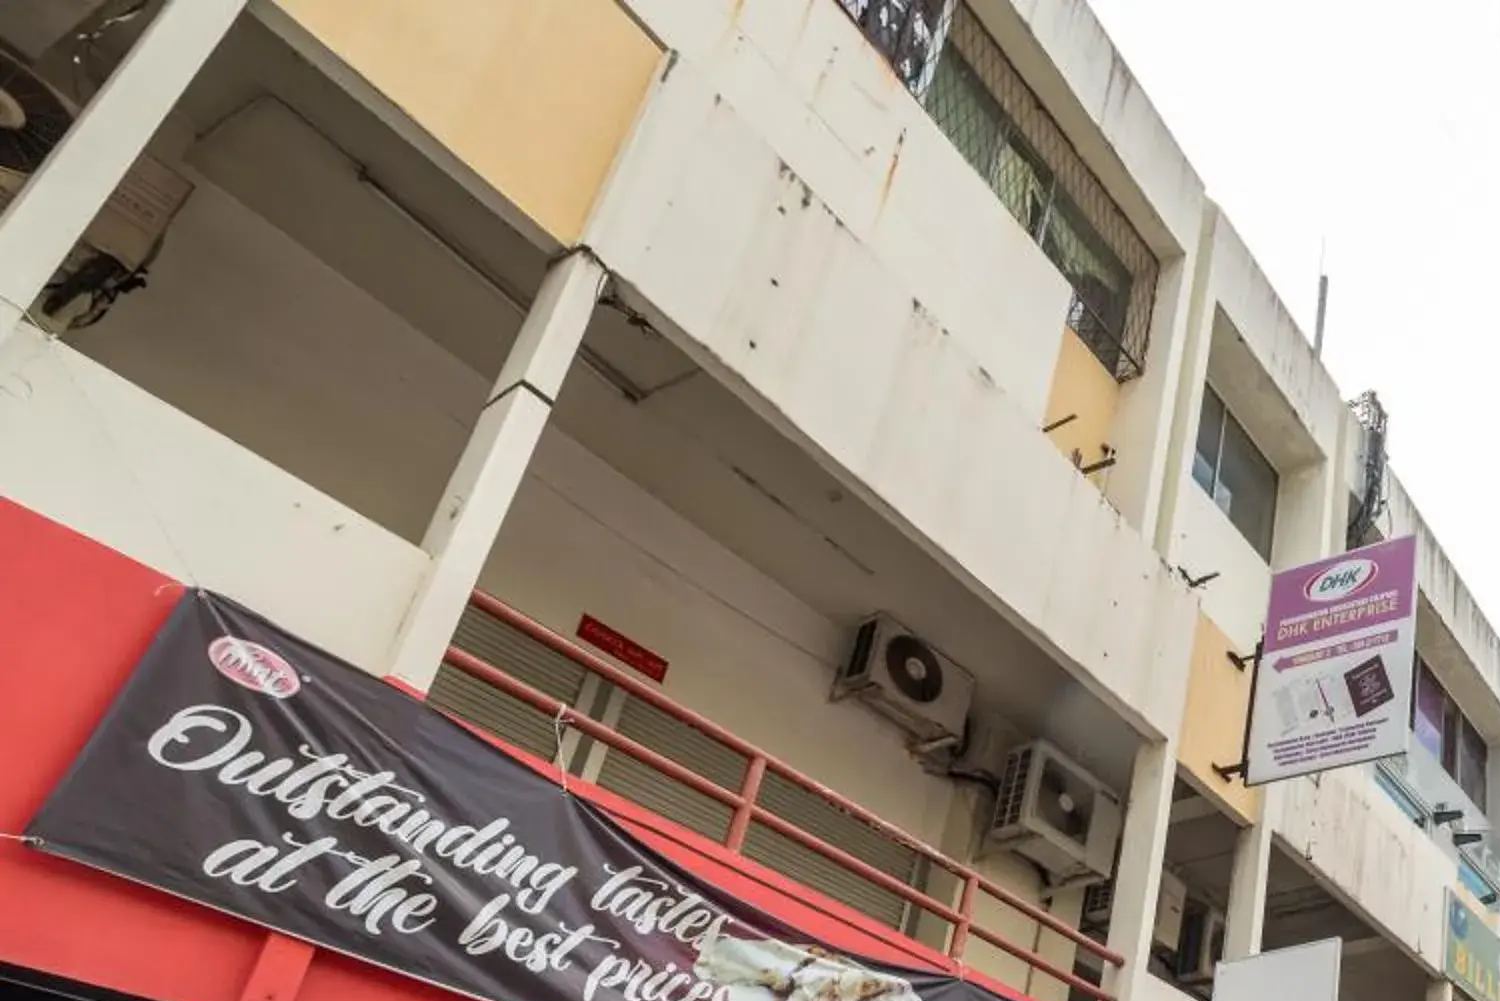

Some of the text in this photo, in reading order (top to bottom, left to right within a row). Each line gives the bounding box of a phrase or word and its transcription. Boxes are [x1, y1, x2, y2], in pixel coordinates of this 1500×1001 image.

[1277, 621, 1308, 641] DHK
[1313, 599, 1399, 631] ENTERPRISE
[1320, 566, 1361, 593] DHK
[147, 702, 735, 950] Outstanding tastes
[203, 831, 337, 893] at
[325, 850, 437, 936] the
[458, 891, 638, 974] best
